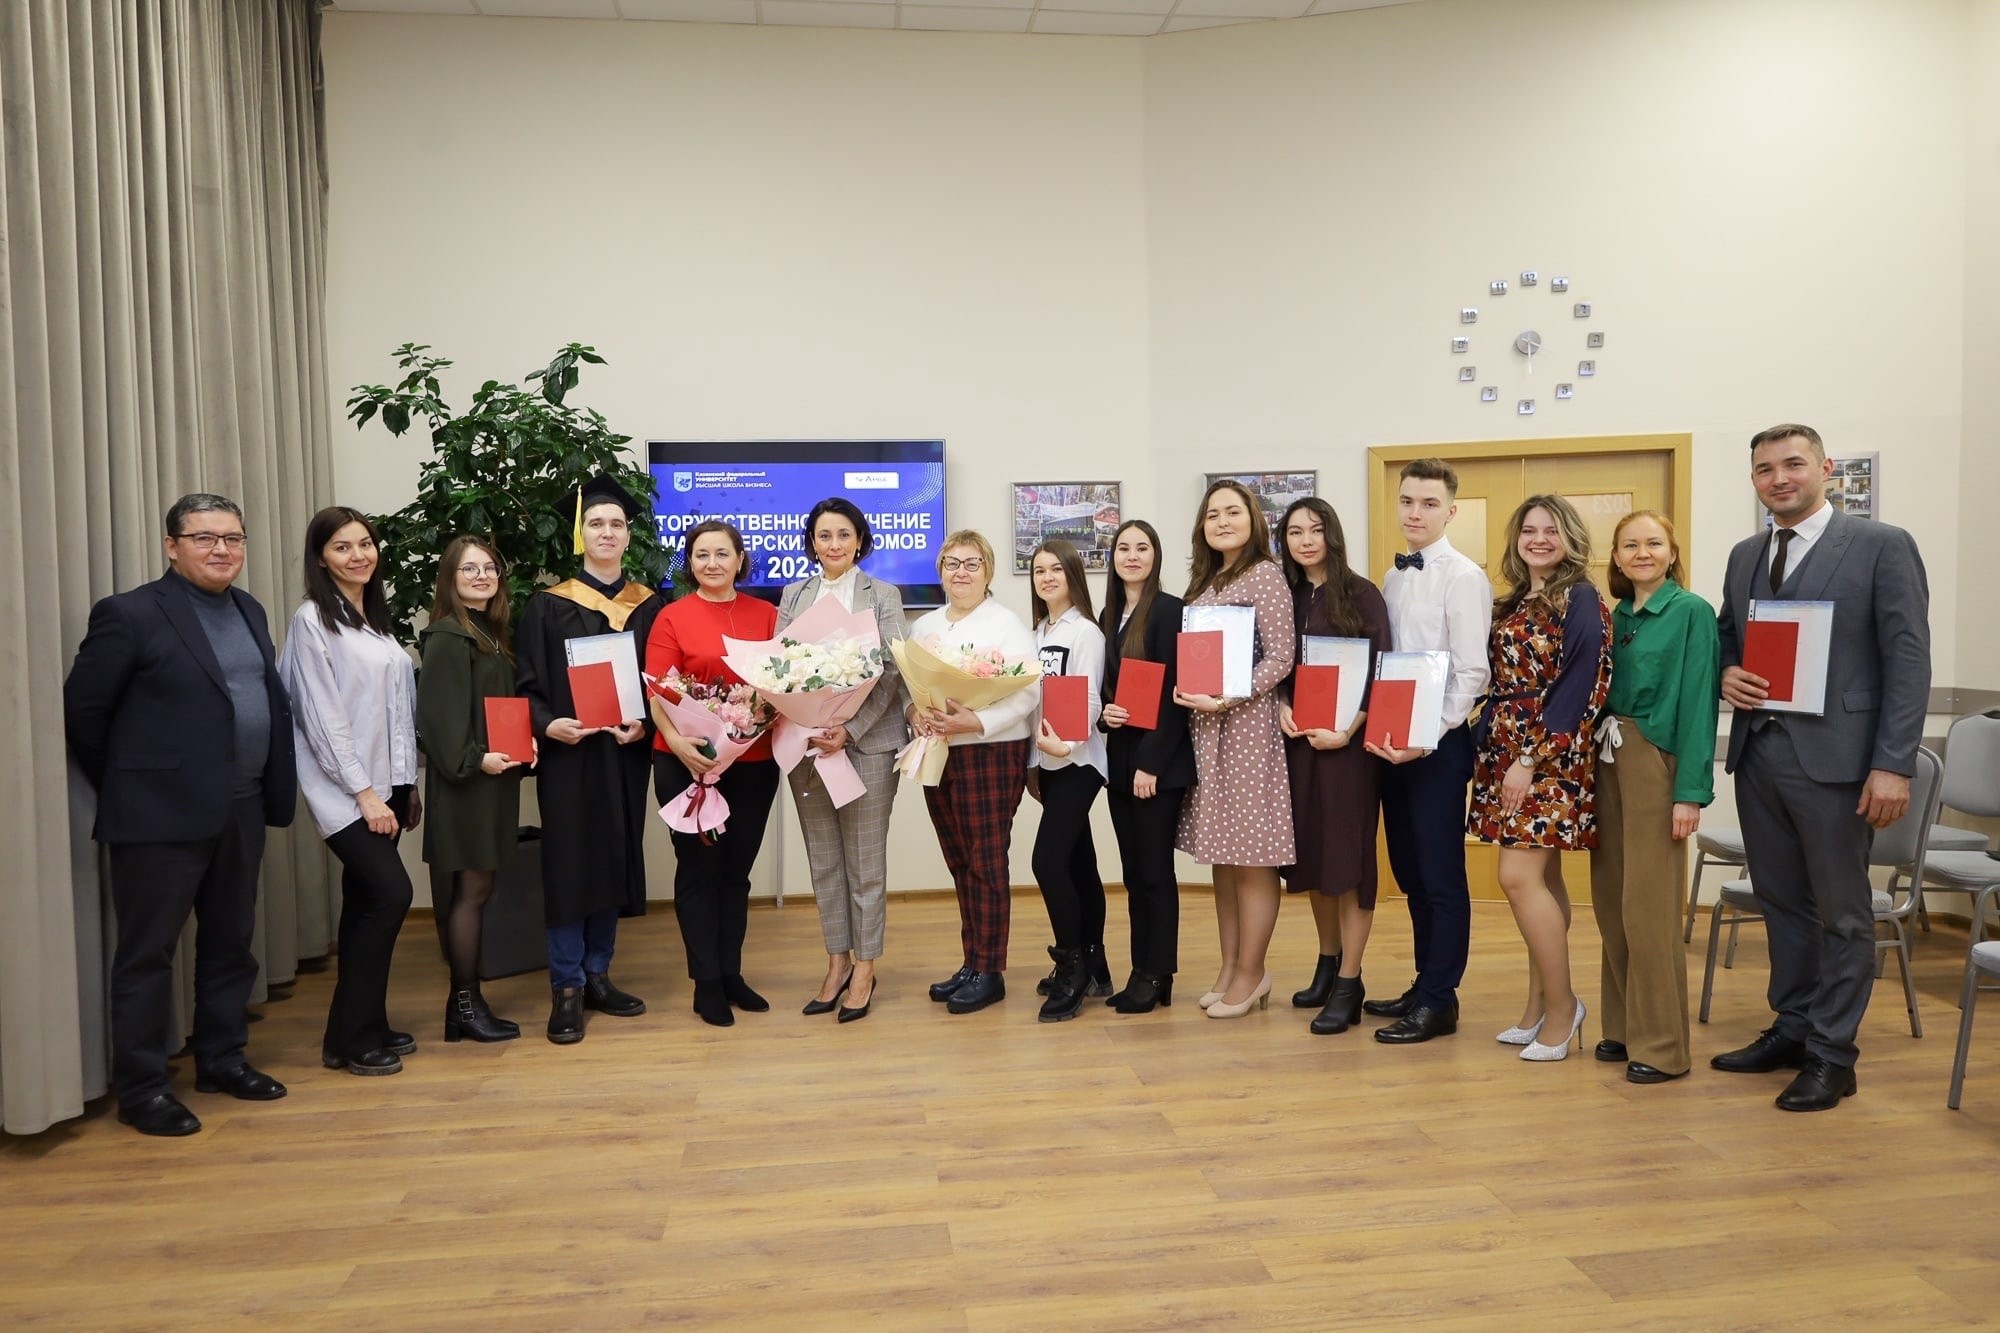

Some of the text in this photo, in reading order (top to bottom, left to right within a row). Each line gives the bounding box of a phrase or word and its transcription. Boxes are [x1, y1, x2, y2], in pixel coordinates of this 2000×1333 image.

[1525, 273, 1536, 283] 12
[1495, 282, 1505, 292] 11
[1465, 310, 1476, 320] 10
